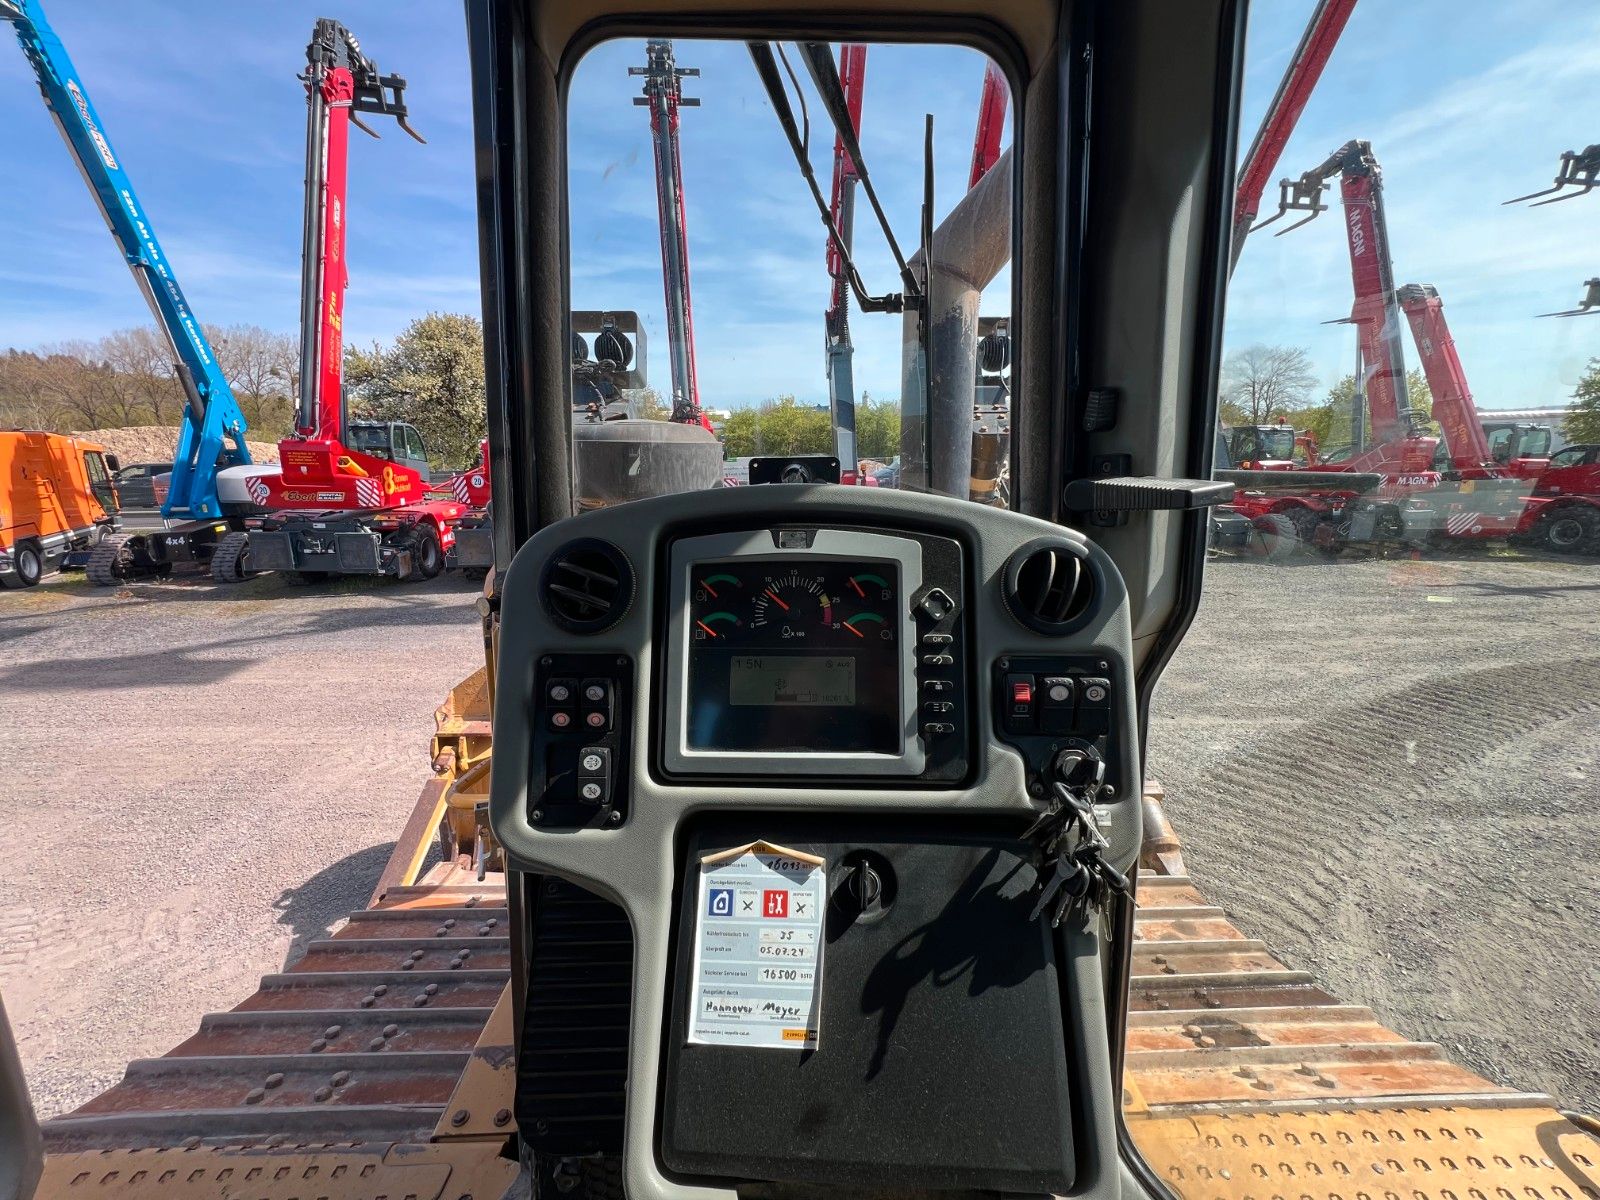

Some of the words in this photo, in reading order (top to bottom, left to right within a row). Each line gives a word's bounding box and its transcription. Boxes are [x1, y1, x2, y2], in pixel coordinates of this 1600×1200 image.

[121, 189, 139, 218] 22m
[1350, 208, 1366, 257] MAGNI
[329, 290, 337, 327] 27m
[383, 466, 395, 495] 8
[473, 477, 482, 486] 20
[1397, 476, 1429, 485] MAGNI
[259, 485, 268, 495] 20
[165, 536, 186, 546] 4x4
[766, 857, 801, 871] 16013
[780, 930, 795, 941] 35
[759, 946, 804, 957] 05.07.24
[763, 968, 797, 981] 16500
[705, 1001, 753, 1014] Hannover
[762, 1002, 801, 1019] Meyer
